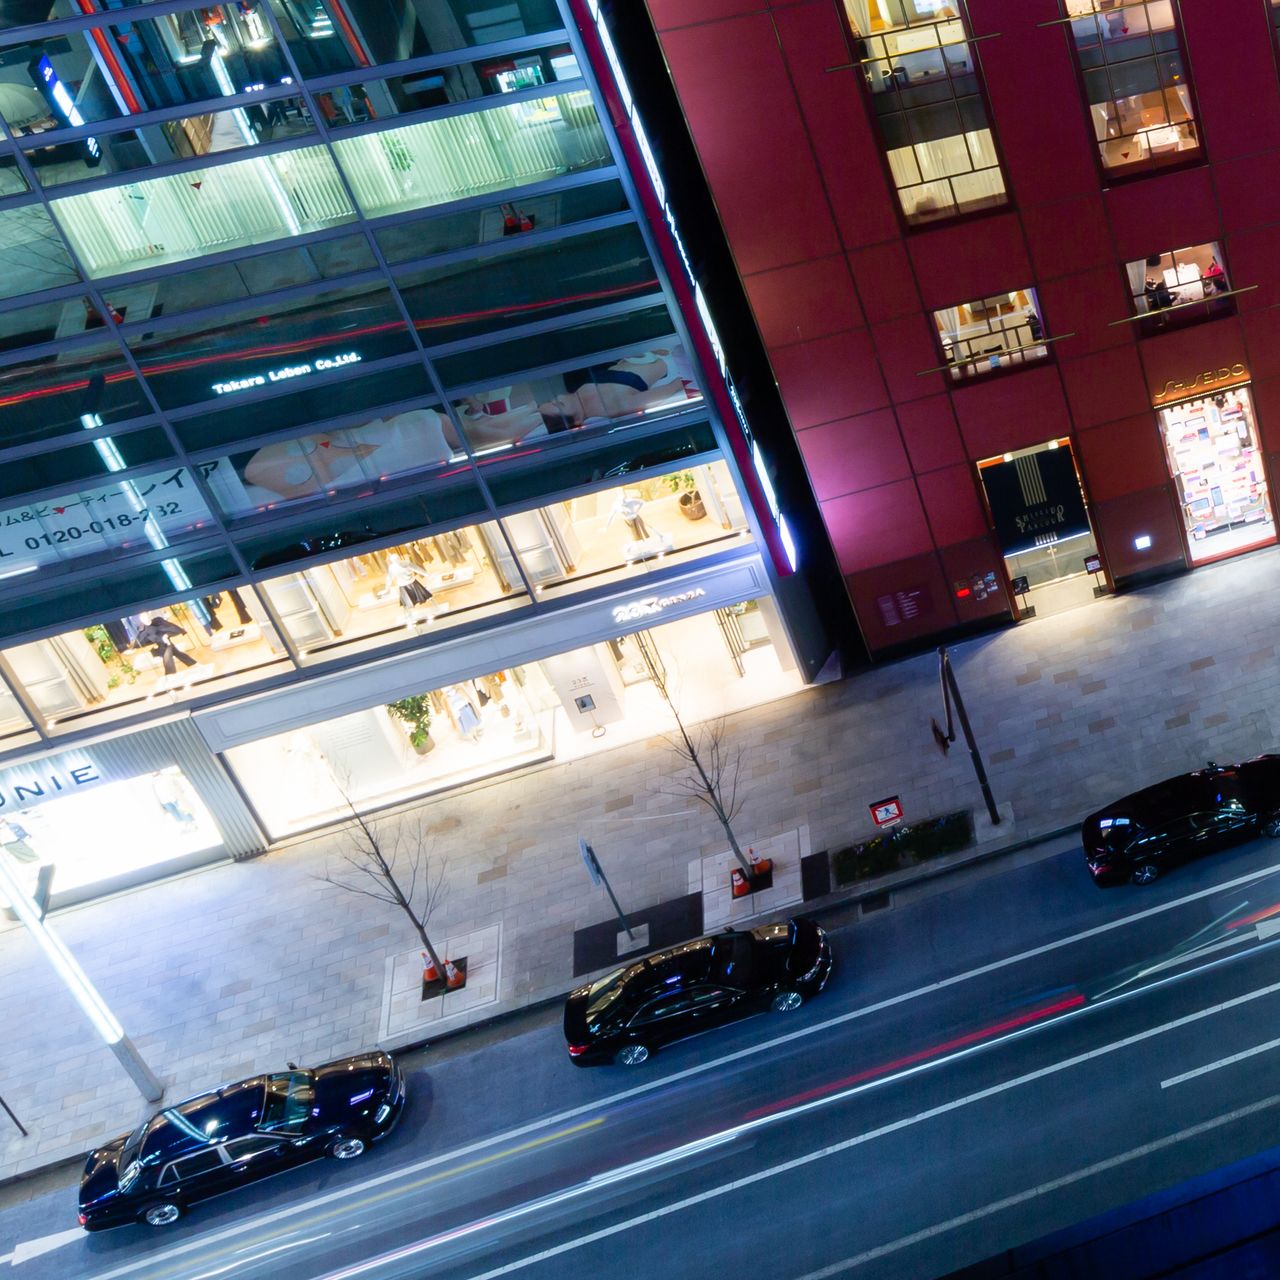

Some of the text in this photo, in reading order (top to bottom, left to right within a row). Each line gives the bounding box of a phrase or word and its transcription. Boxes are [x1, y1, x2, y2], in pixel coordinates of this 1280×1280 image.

[211, 375, 265, 394] Takara
[268, 364, 311, 381] Leben
[1155, 363, 1246, 398] SHISEIDO
[0, 764, 100, 808] NIE
